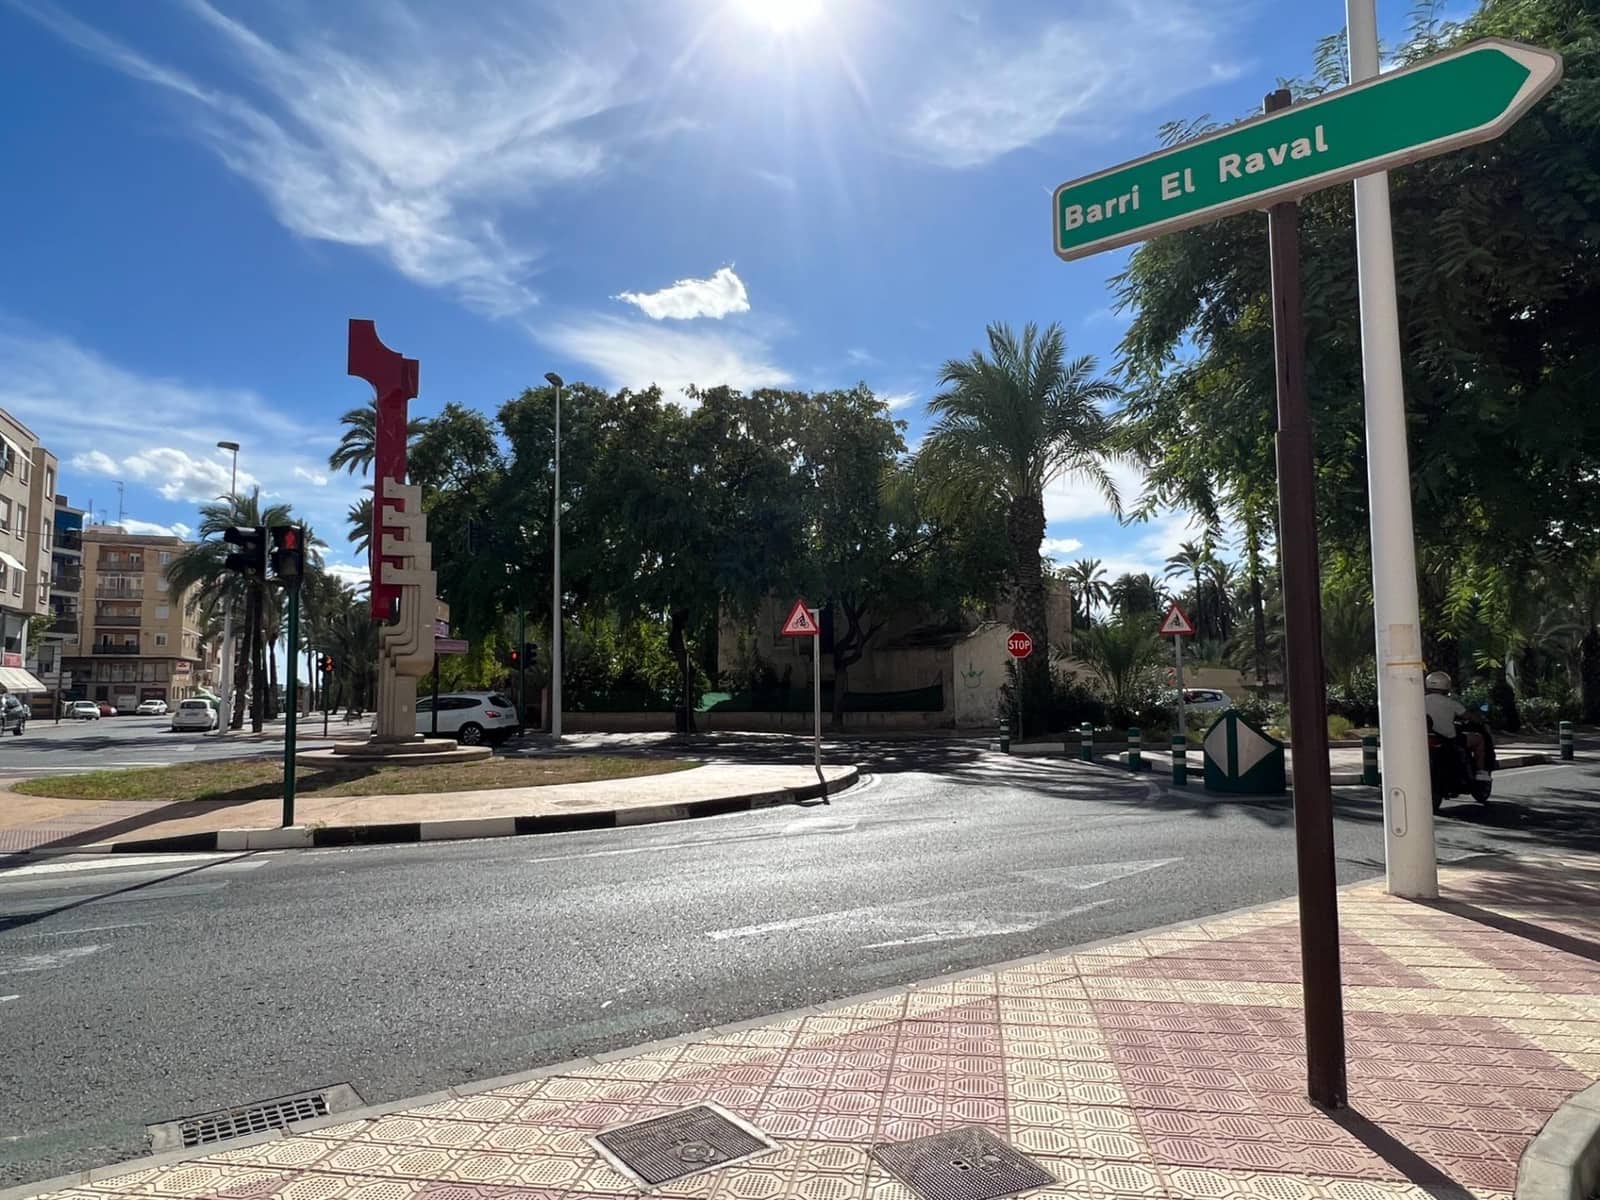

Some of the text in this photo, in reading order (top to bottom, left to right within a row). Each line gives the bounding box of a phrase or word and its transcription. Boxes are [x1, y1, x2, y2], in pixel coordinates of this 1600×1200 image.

[1065, 125, 1329, 231] Barri El Raval
[1008, 640, 1030, 650] STOP
